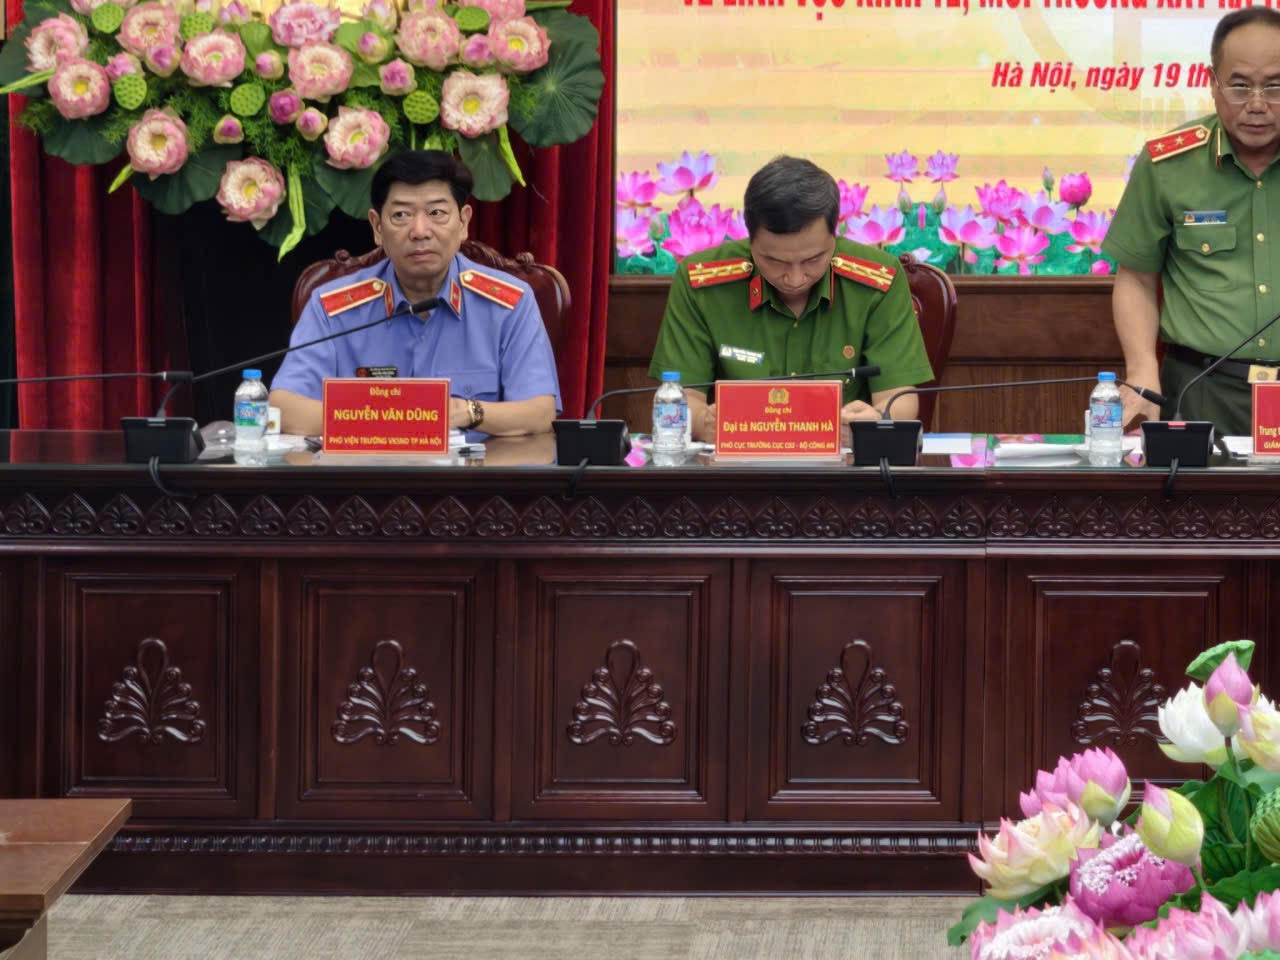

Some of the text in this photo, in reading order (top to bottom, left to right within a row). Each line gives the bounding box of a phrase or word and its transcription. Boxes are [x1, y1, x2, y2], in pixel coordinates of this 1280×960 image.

[991, 62, 1024, 87] Hà
[1030, 62, 1076, 93] Nội,
[1085, 62, 1144, 91] ngày
[1152, 63, 1181, 87] 19
[382, 408, 403, 420] VĂN
[788, 422, 819, 431] THANH
